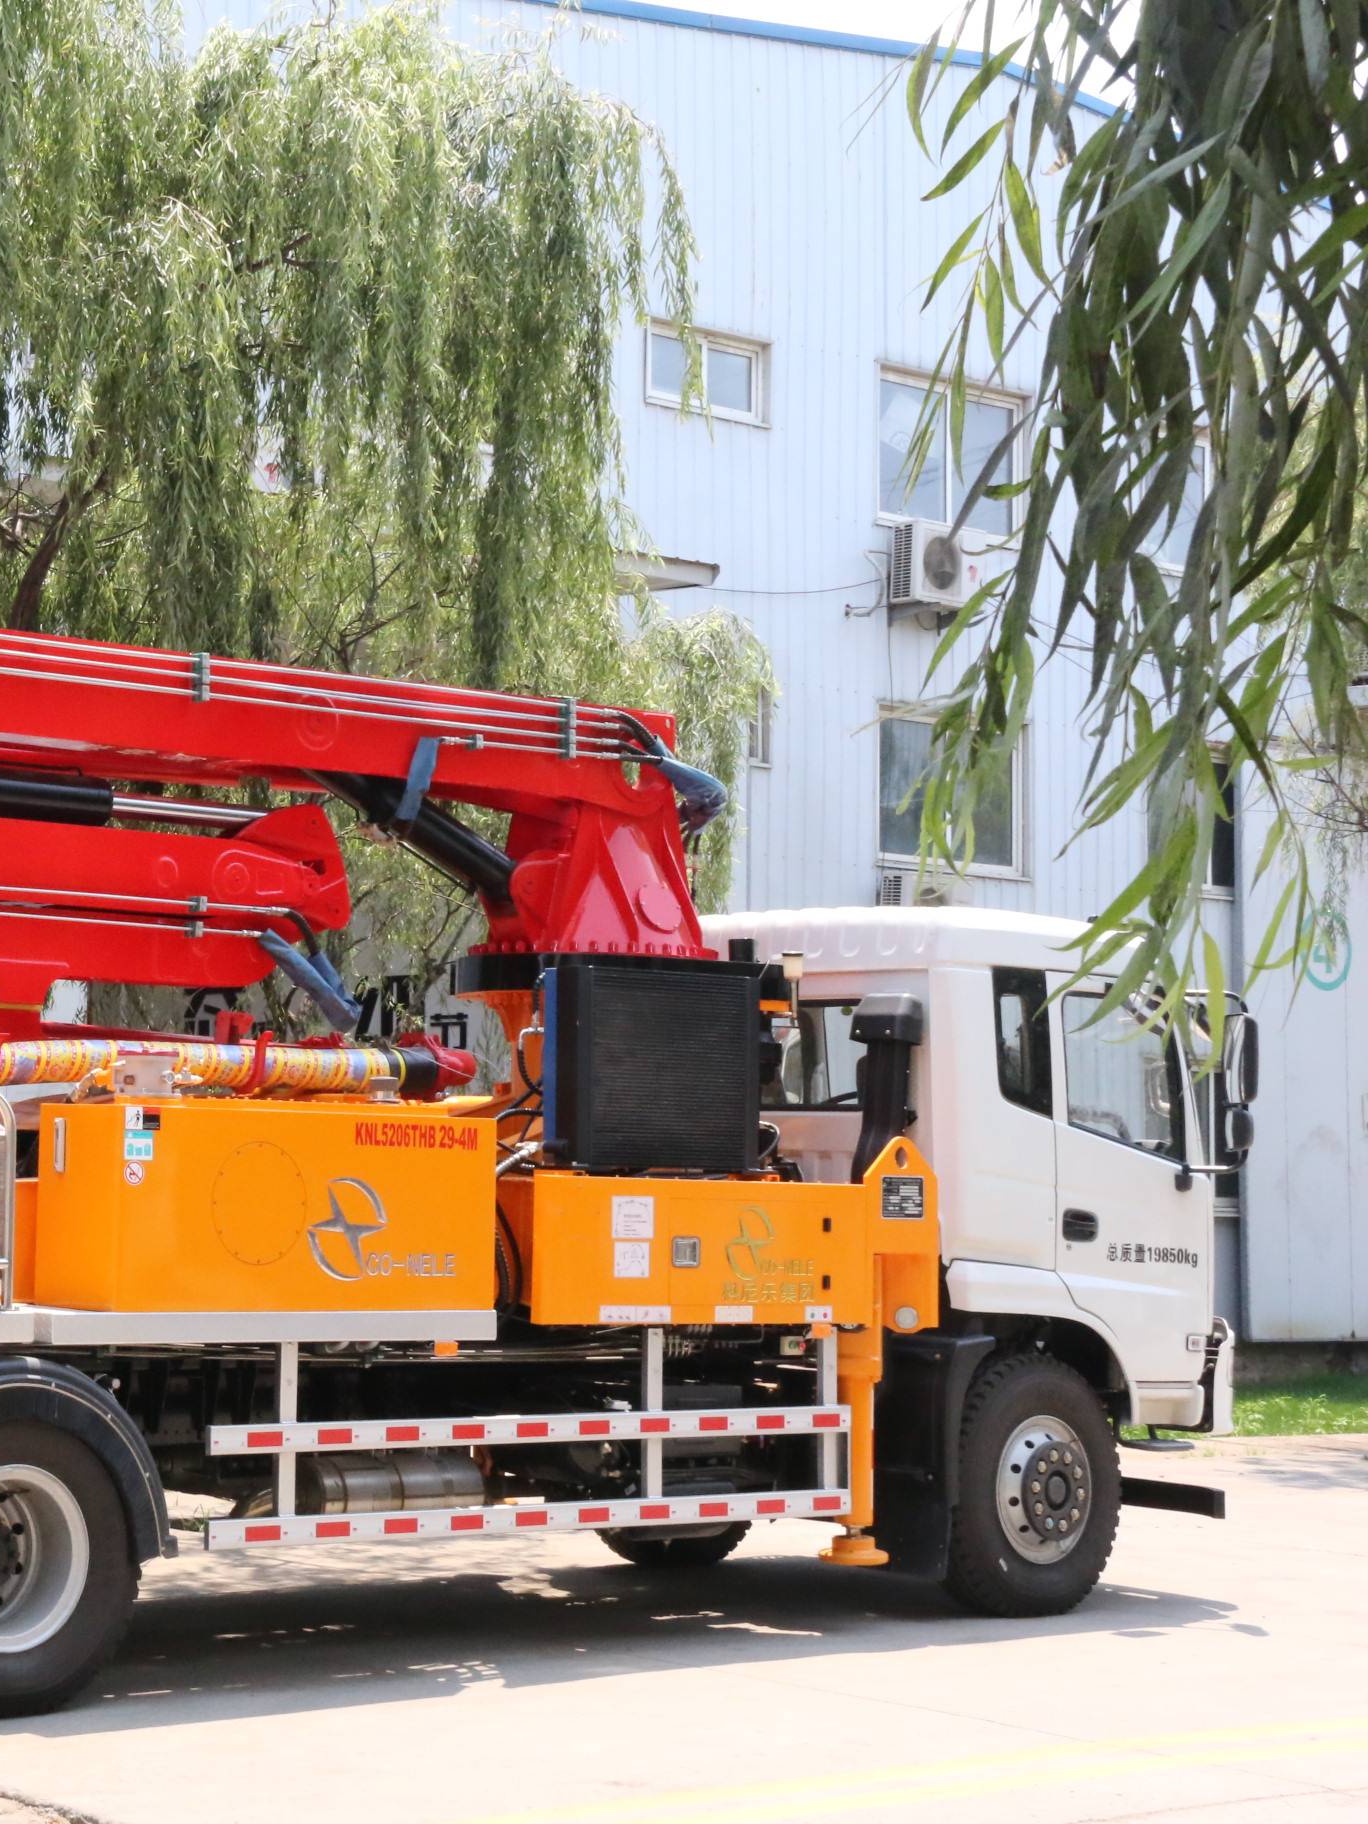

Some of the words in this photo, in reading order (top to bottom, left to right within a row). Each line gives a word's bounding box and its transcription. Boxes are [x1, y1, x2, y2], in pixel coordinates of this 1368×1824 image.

[354, 1122, 436, 1149] KNL5206THB
[439, 1126, 478, 1151] 29-4M
[365, 1253, 457, 1277] CO-NELE
[1106, 1243, 1199, 1268] 总质量19850kg
